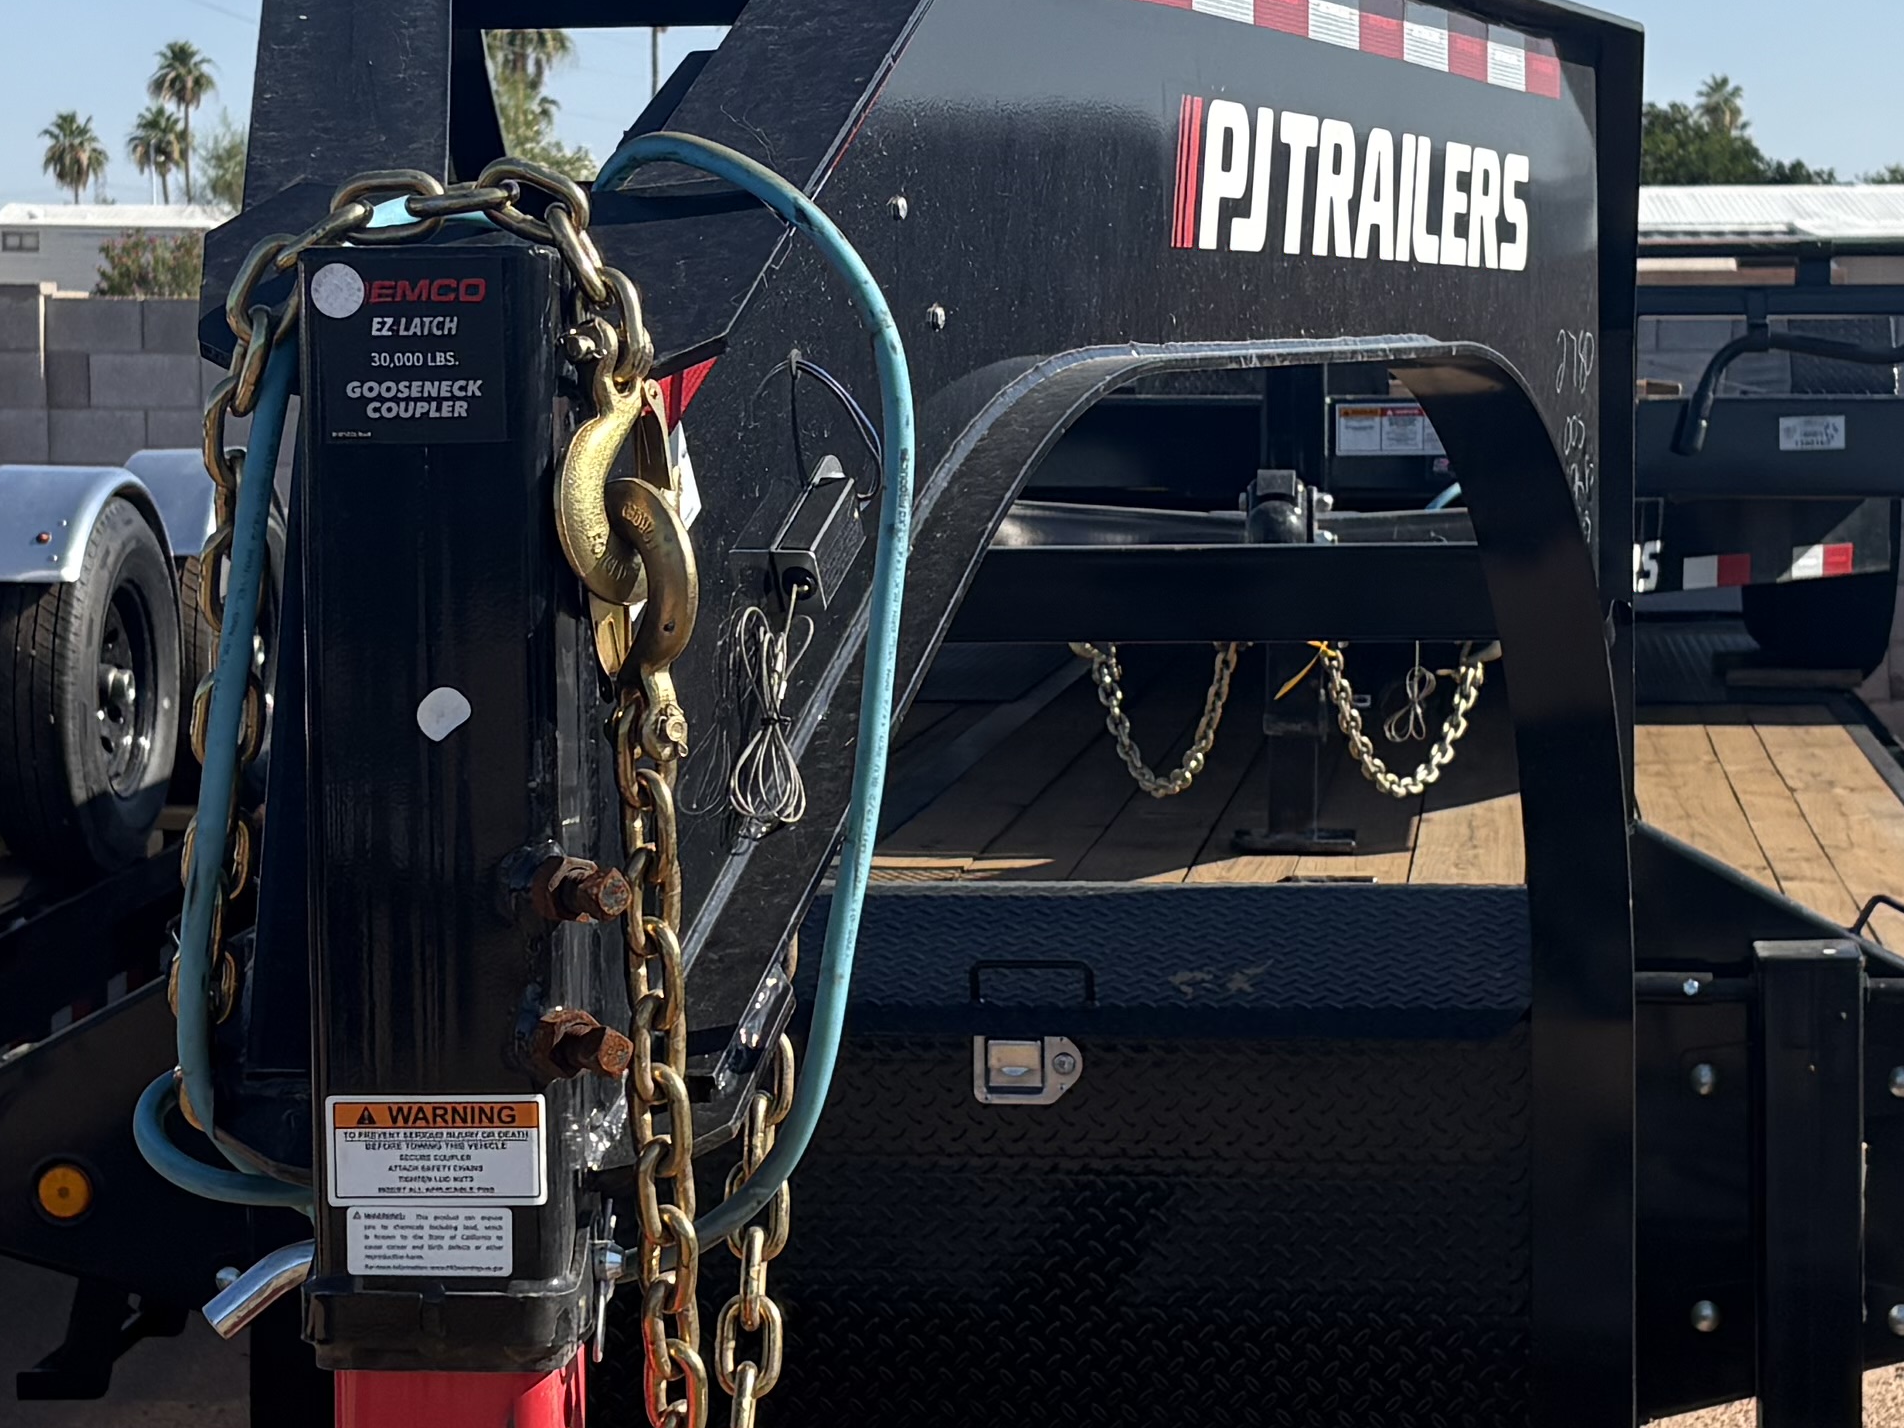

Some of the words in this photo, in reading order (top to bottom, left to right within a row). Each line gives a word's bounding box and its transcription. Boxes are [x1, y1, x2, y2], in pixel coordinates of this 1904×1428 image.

[1280, 111, 1530, 271] TRAILERS
[364, 278, 487, 304] EMCO
[371, 353, 423, 368] 30,000
[428, 352, 459, 366] LBS.
[346, 380, 483, 399] GOOSENECK
[366, 401, 468, 419] COUPLER
[388, 1105, 516, 1125] WARNING
